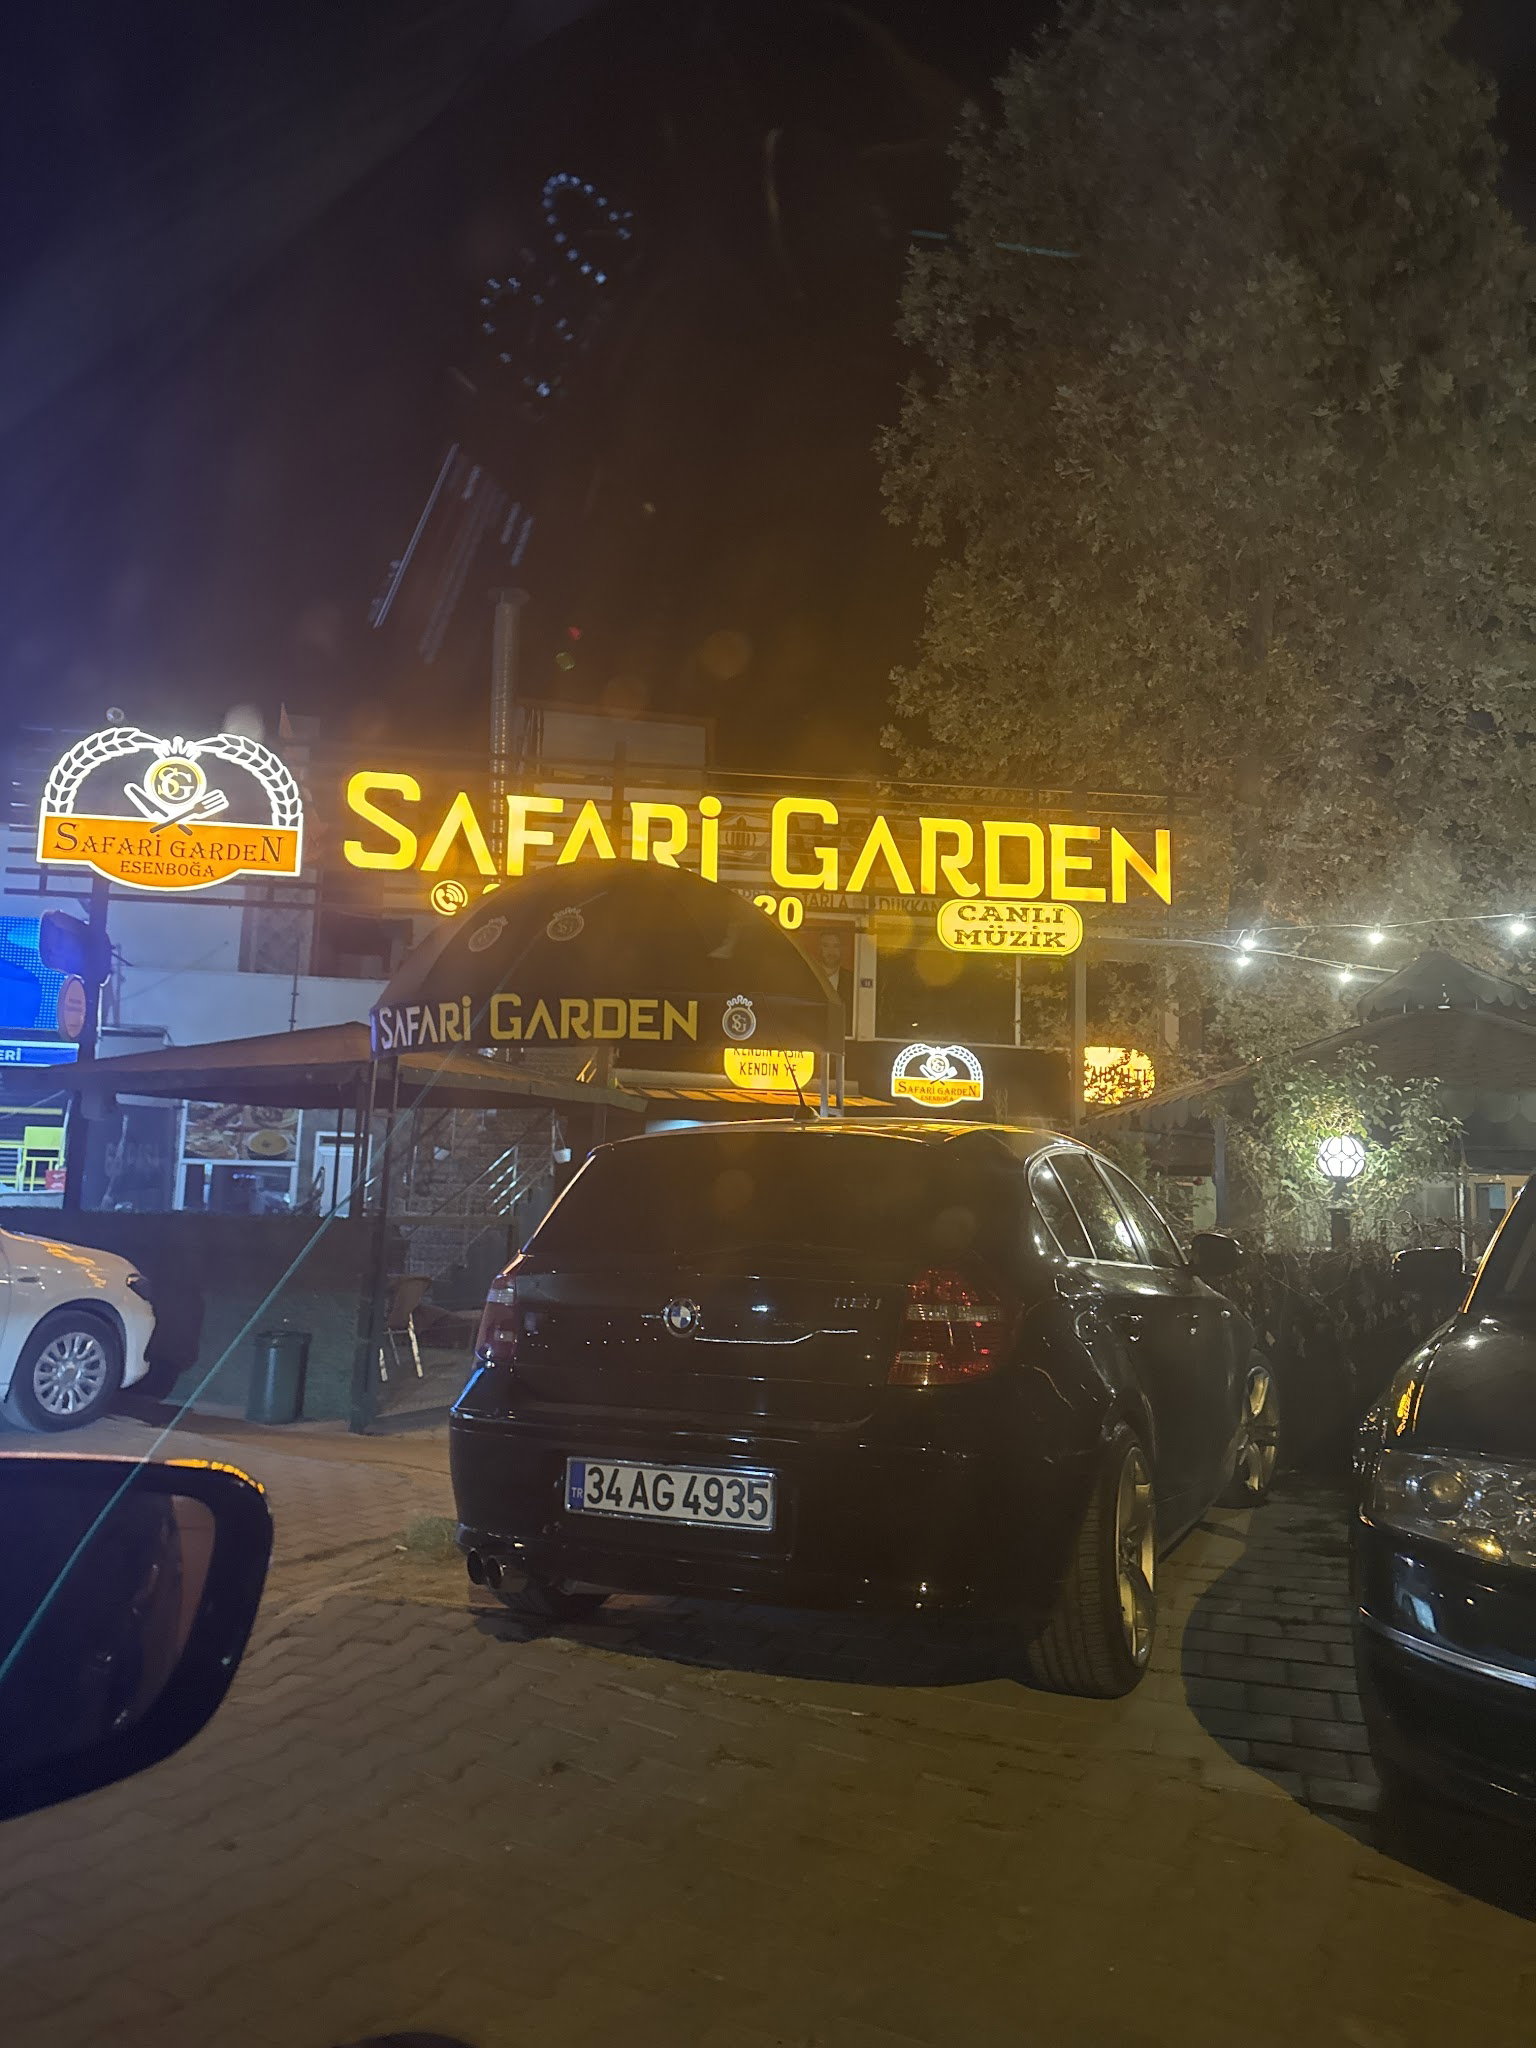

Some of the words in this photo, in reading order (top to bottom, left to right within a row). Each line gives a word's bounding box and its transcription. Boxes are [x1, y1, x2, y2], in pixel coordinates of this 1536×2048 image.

[169, 834, 284, 864] GARDEN
[770, 796, 1172, 905] GARDEN
[120, 860, 216, 878] ESENBOĞA
[957, 905, 1065, 924] CANLI
[953, 924, 1066, 948] MÜZİK
[489, 992, 698, 1042] GARDEN
[937, 1085, 977, 1097] GARDEN
[571, 1486, 584, 1500] TR
[586, 1466, 623, 1508] 34
[628, 1470, 675, 1512] AG
[682, 1475, 769, 1522] 4935
